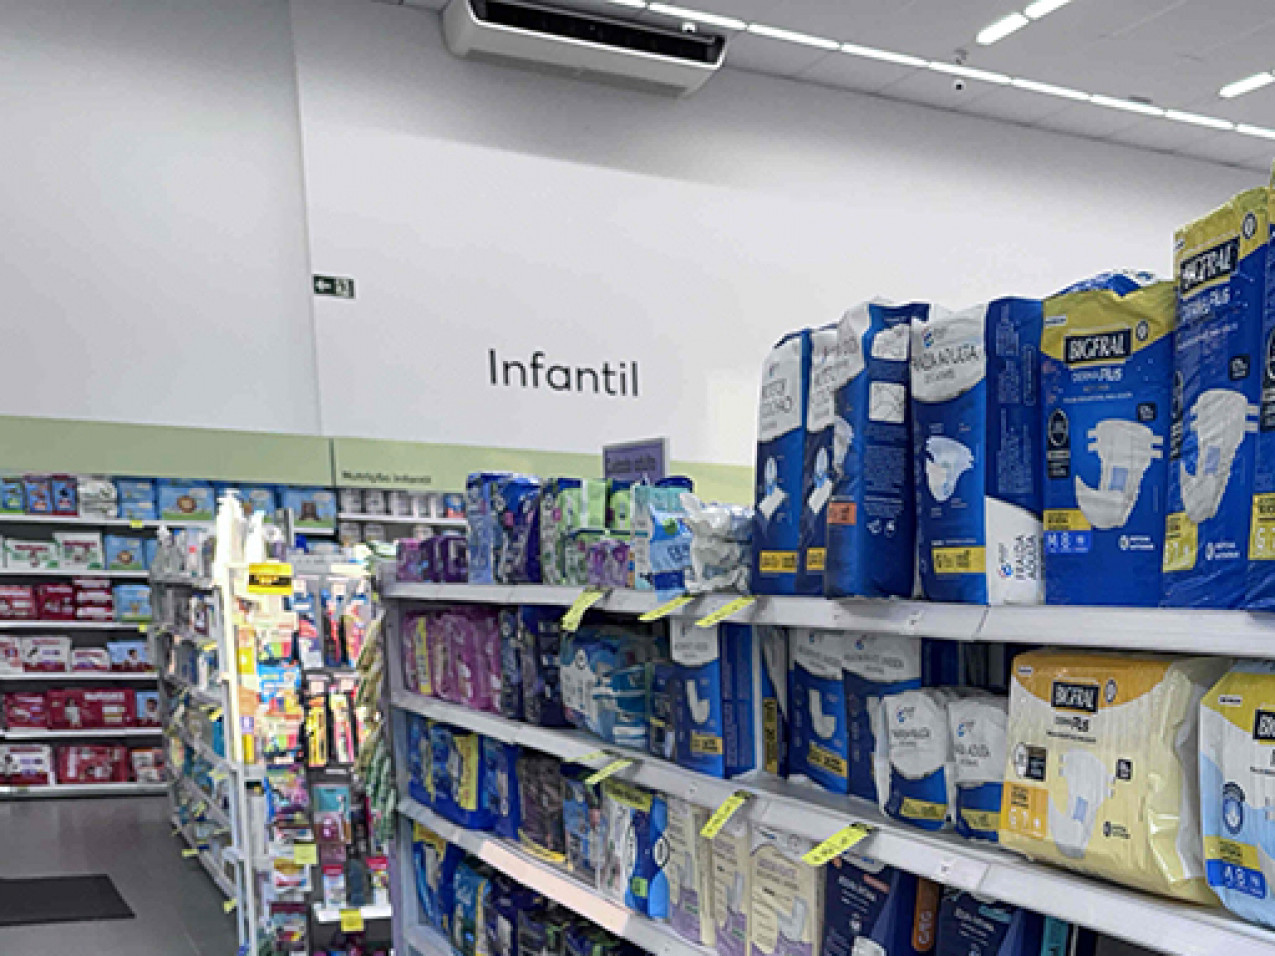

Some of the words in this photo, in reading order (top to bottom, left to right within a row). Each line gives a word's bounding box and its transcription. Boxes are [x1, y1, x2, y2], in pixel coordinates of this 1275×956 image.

[1069, 333, 1125, 360] BIGFRAL
[488, 348, 640, 397] Infantil
[1054, 683, 1096, 710] BIGFRAL
